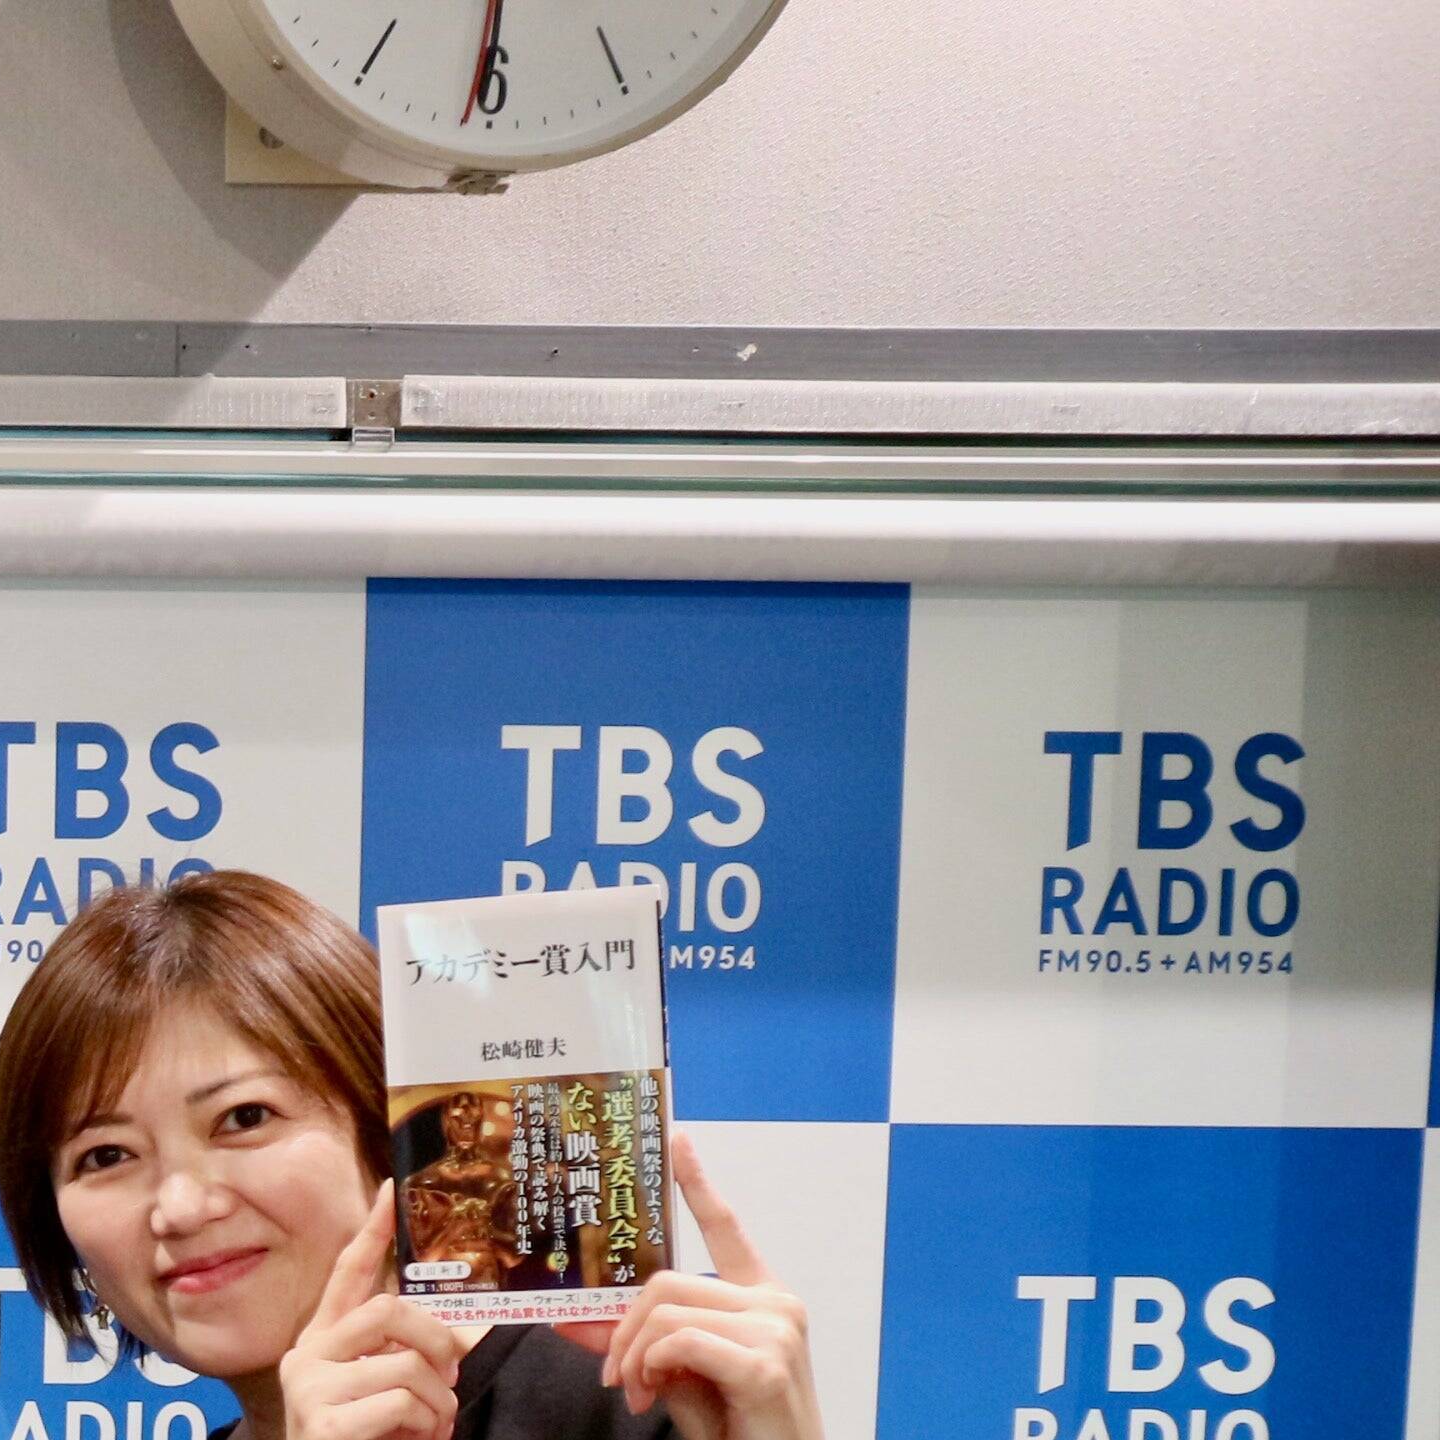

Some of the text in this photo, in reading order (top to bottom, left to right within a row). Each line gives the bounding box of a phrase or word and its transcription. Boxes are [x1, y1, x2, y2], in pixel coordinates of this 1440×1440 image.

[477, 45, 509, 115] 6
[501, 724, 766, 848] TBS
[1044, 731, 1306, 852] TBS
[1040, 866, 1300, 937] RADIO
[405, 938, 635, 986] アカデミー賞入門
[566, 1082, 603, 1227] ない映画賞
[639, 1078, 664, 1245] 他の映画祭のような
[1017, 1275, 1276, 1395] TBS
